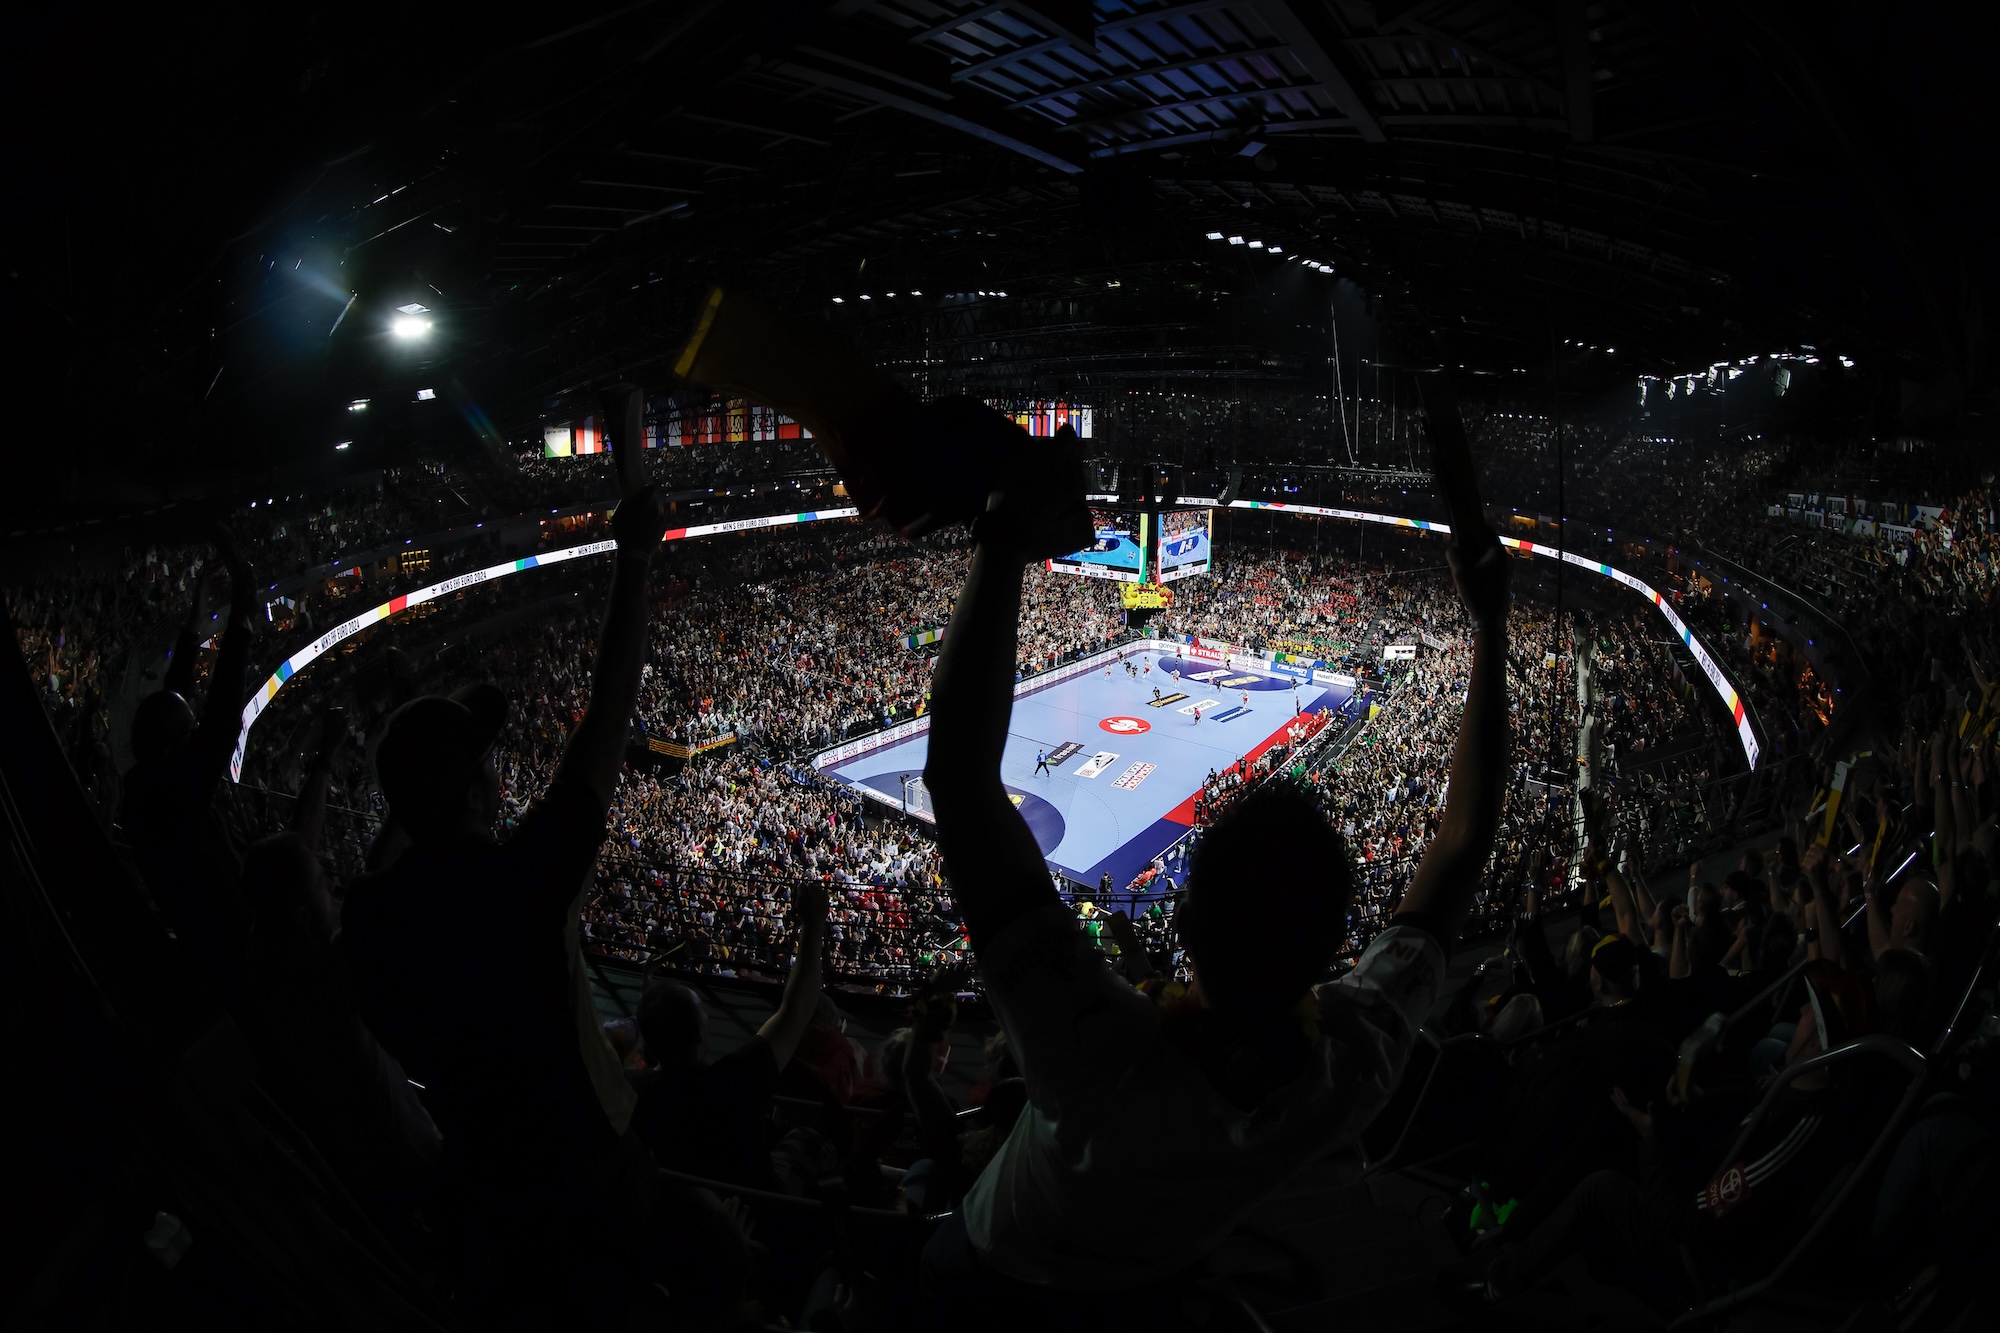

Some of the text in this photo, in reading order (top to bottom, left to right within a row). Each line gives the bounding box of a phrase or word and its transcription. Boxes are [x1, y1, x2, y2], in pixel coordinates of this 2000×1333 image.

[461, 574, 474, 586] EURO
[474, 571, 487, 582] 2024
[1198, 649, 1226, 660] STRAUS
[1277, 663, 1308, 674] FALKEN
